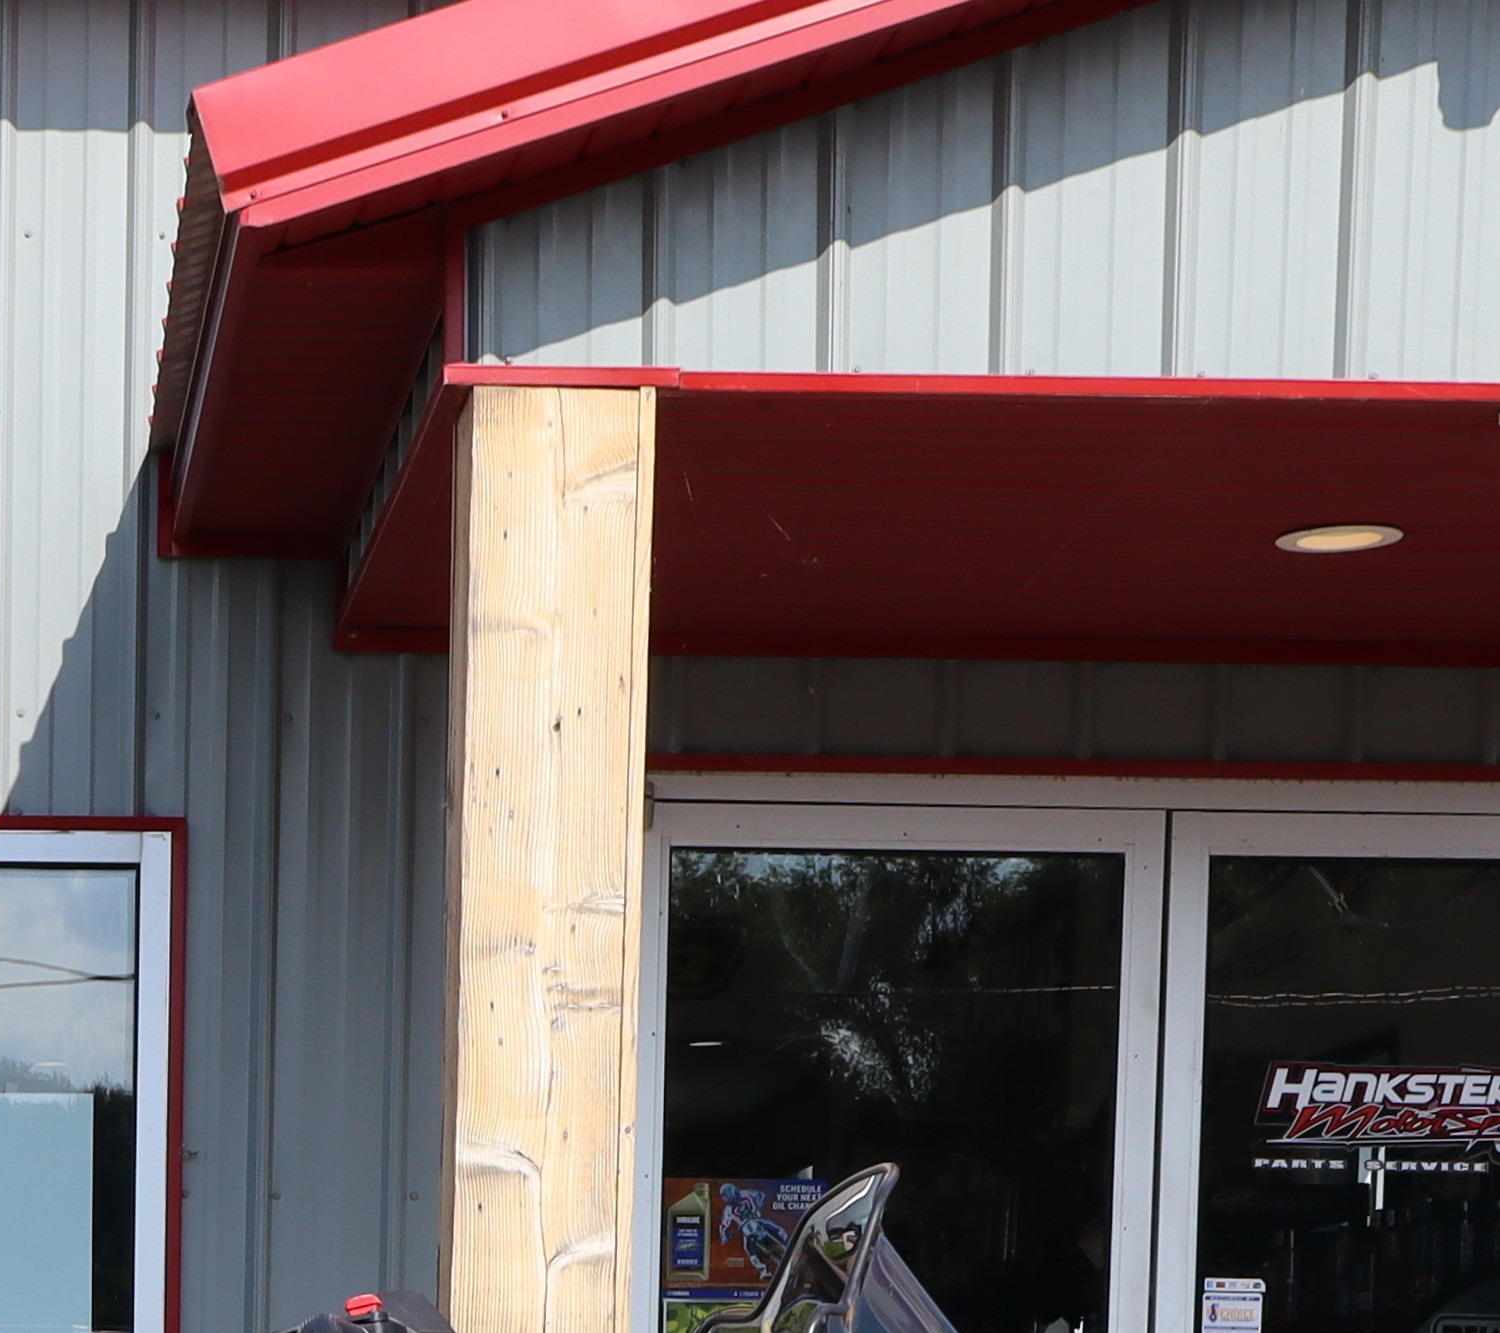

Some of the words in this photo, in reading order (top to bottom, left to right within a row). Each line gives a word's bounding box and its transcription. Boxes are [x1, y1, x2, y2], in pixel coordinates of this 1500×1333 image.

[1253, 1157, 1347, 1171] PARTS
[1363, 1158, 1489, 1173] SERVICE
[779, 1184, 822, 1193] SCHEDULE
[776, 1193, 799, 1201] YOUR
[772, 1202, 786, 1210] OIL
